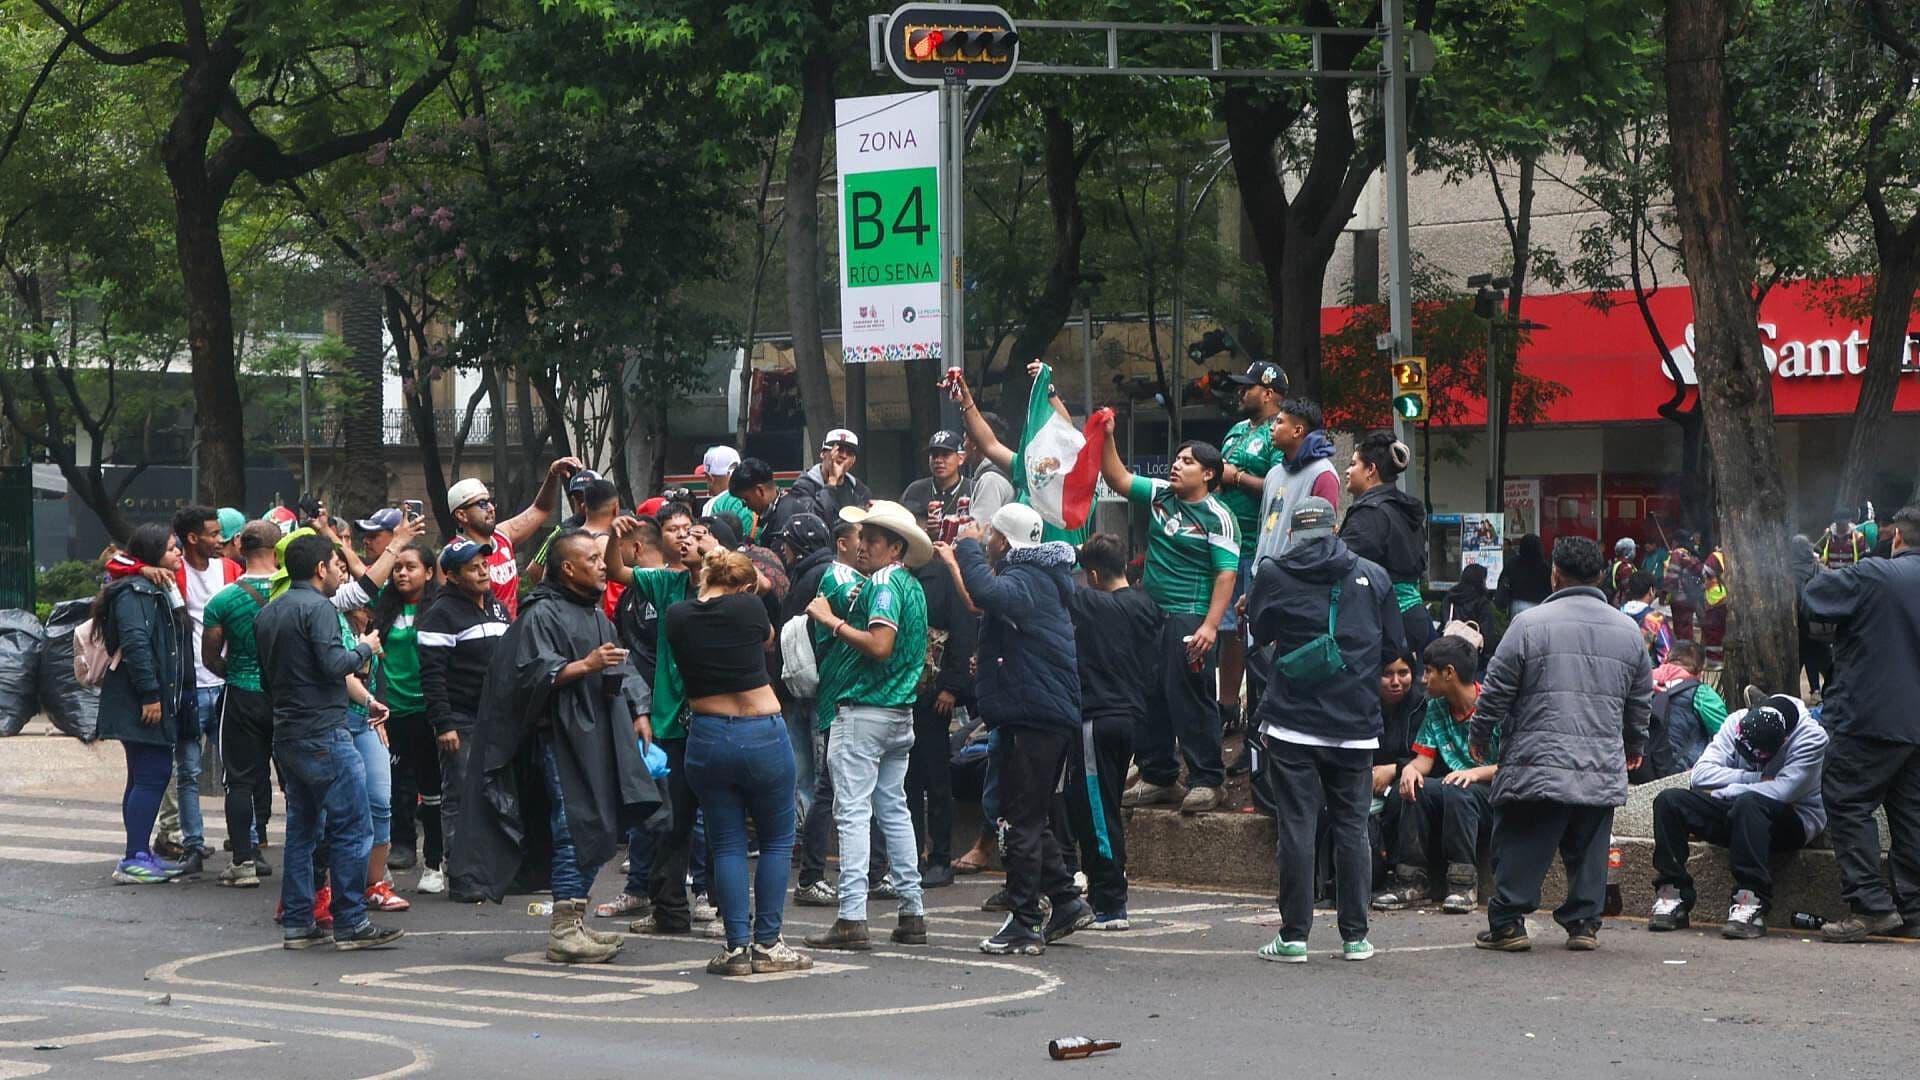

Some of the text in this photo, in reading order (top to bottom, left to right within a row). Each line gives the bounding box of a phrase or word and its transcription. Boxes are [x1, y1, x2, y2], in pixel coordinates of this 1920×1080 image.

[859, 129, 918, 153] ZONA
[852, 186, 931, 251] B4
[850, 262, 934, 284] RÍO SENA
[1147, 461, 1168, 475] Loca
